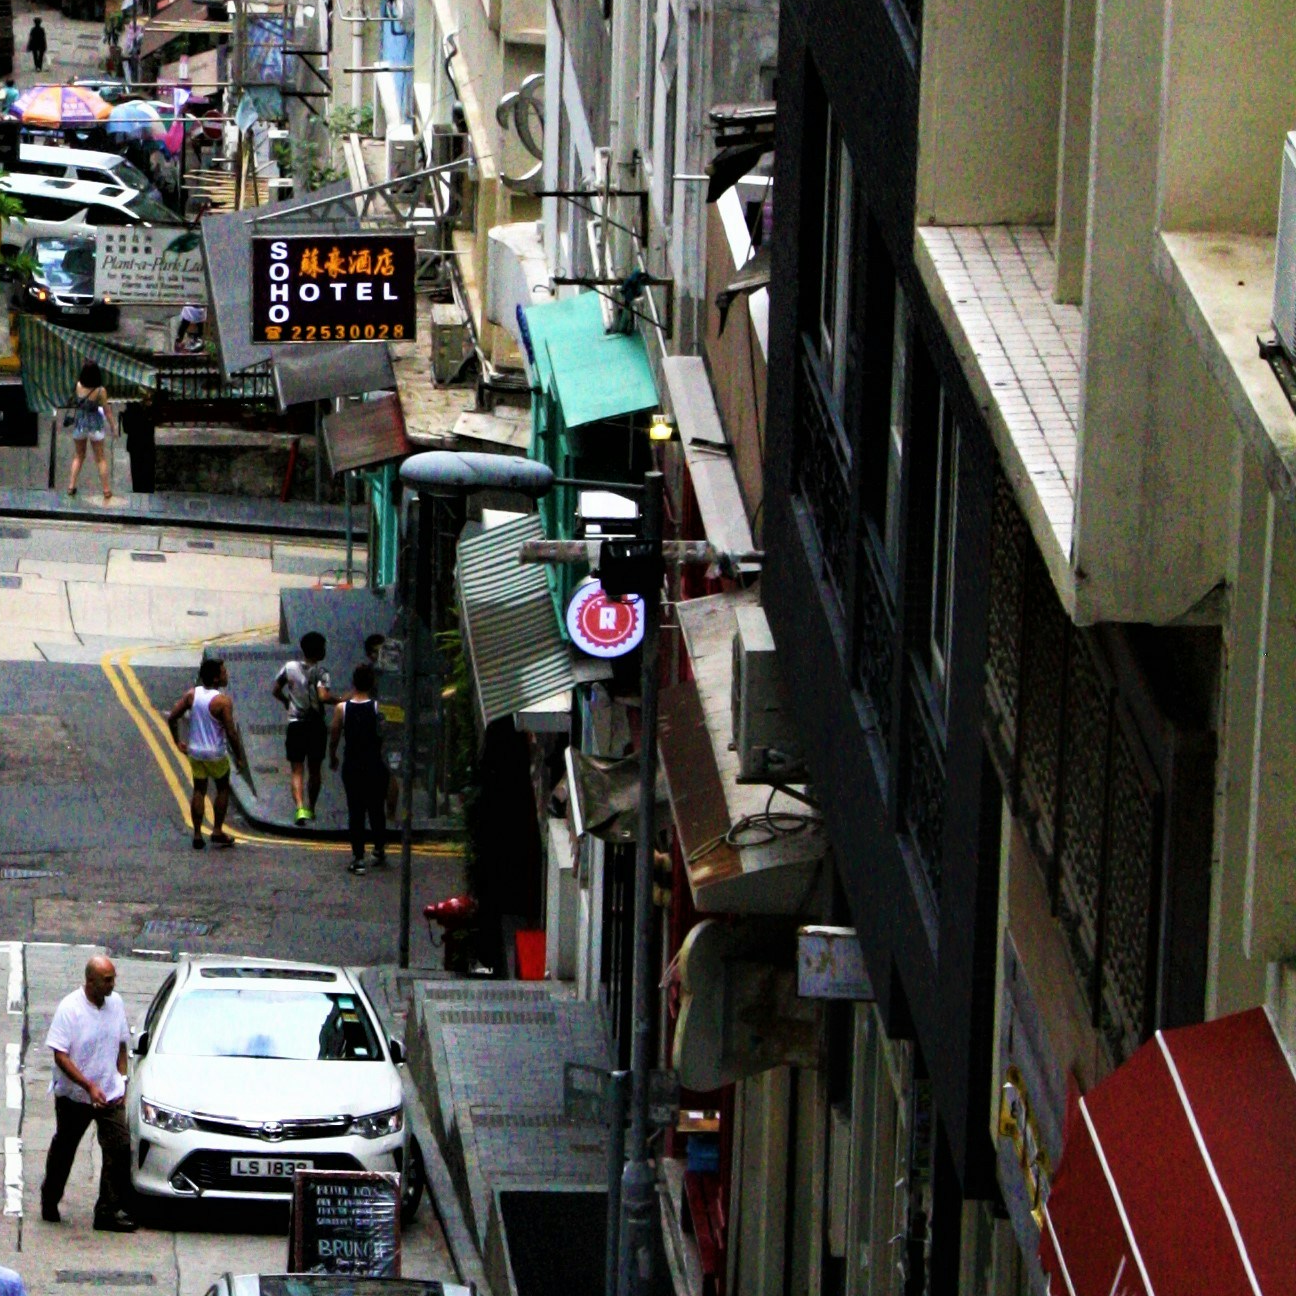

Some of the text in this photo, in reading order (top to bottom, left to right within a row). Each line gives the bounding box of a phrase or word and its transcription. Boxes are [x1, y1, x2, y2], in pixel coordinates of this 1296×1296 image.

[298, 247, 395, 279] 蘇豪酒店
[268, 241, 290, 323] SOHO
[291, 324, 404, 340] 22530028
[599, 607, 616, 630] R
[237, 1161, 259, 1174] LS
